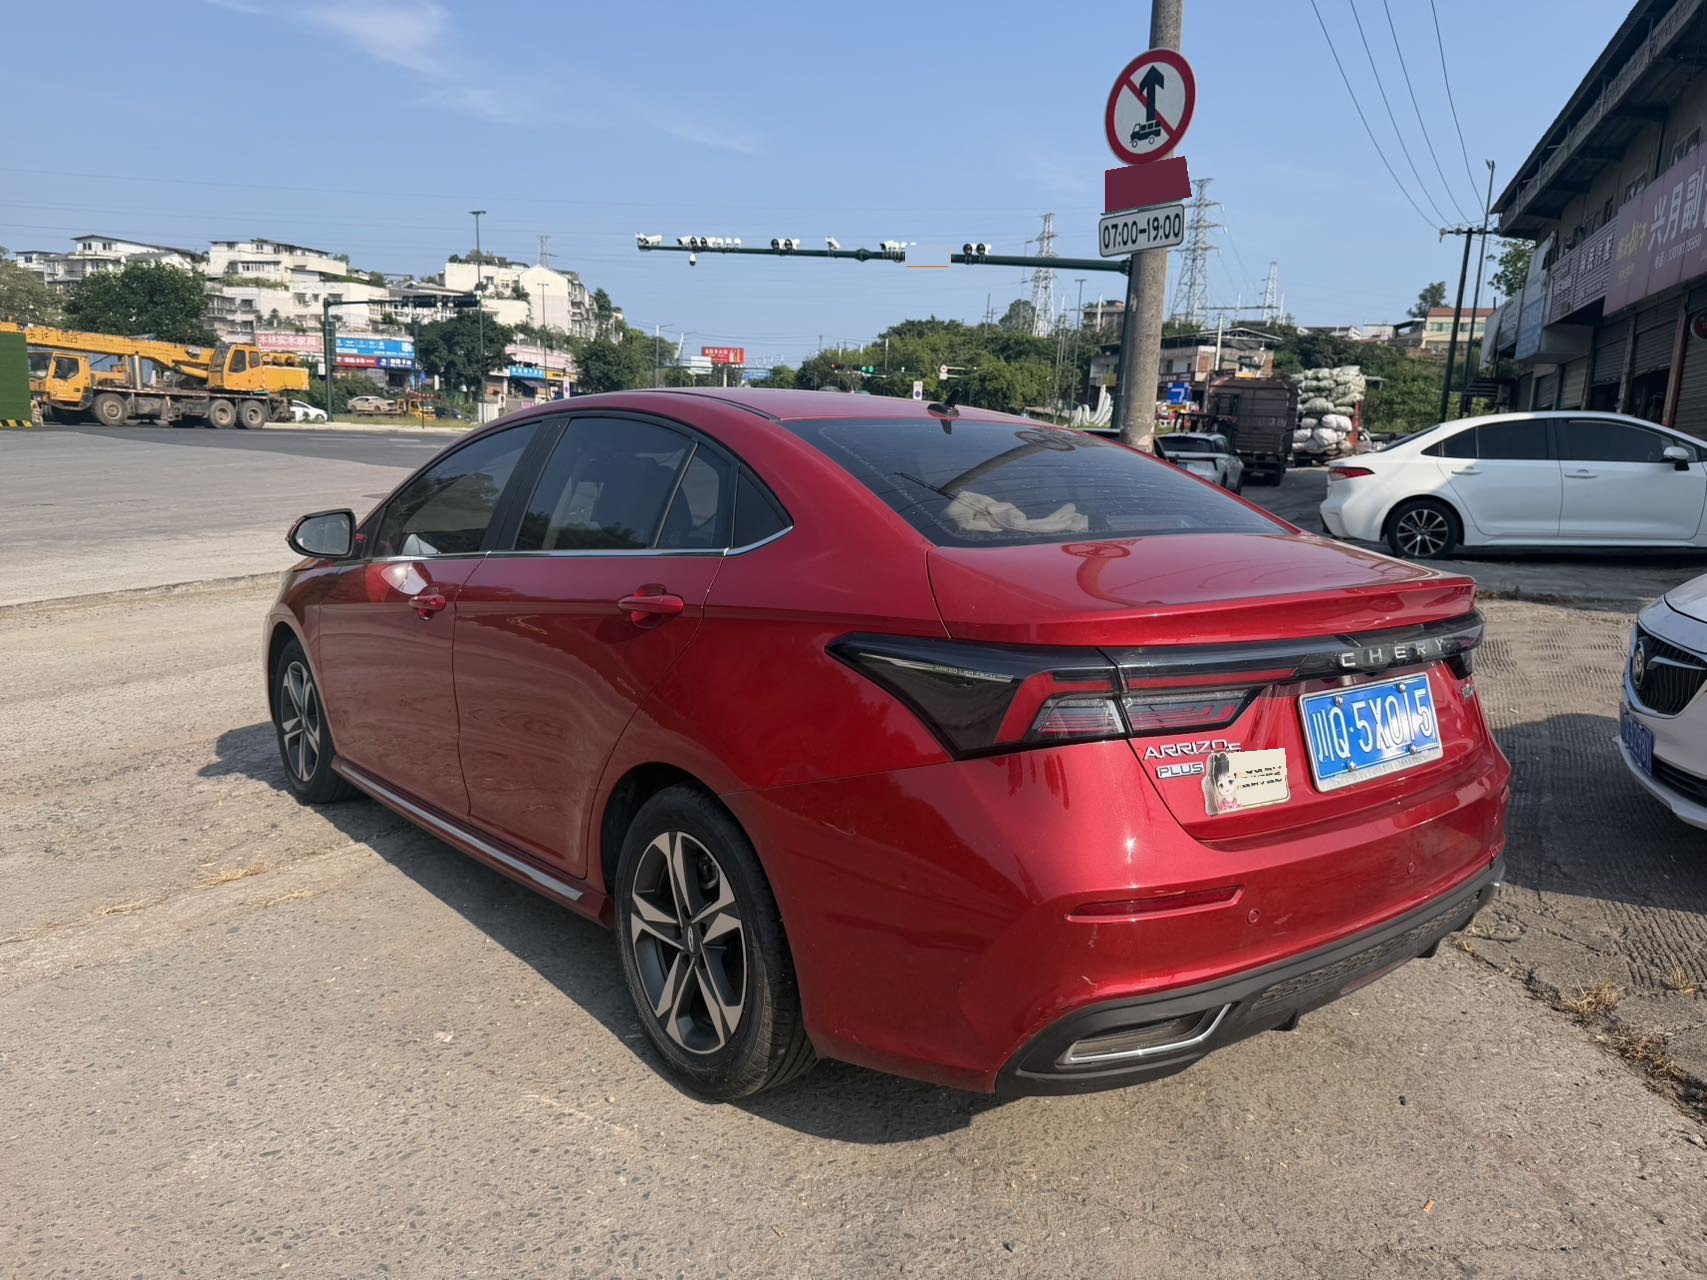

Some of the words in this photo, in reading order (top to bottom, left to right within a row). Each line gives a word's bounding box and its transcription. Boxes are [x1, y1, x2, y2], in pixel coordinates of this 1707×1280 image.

[1102, 212, 1182, 249] 07:00-19:00
[1340, 638, 1444, 667] CHERY
[1159, 762, 1203, 777] PLUS
